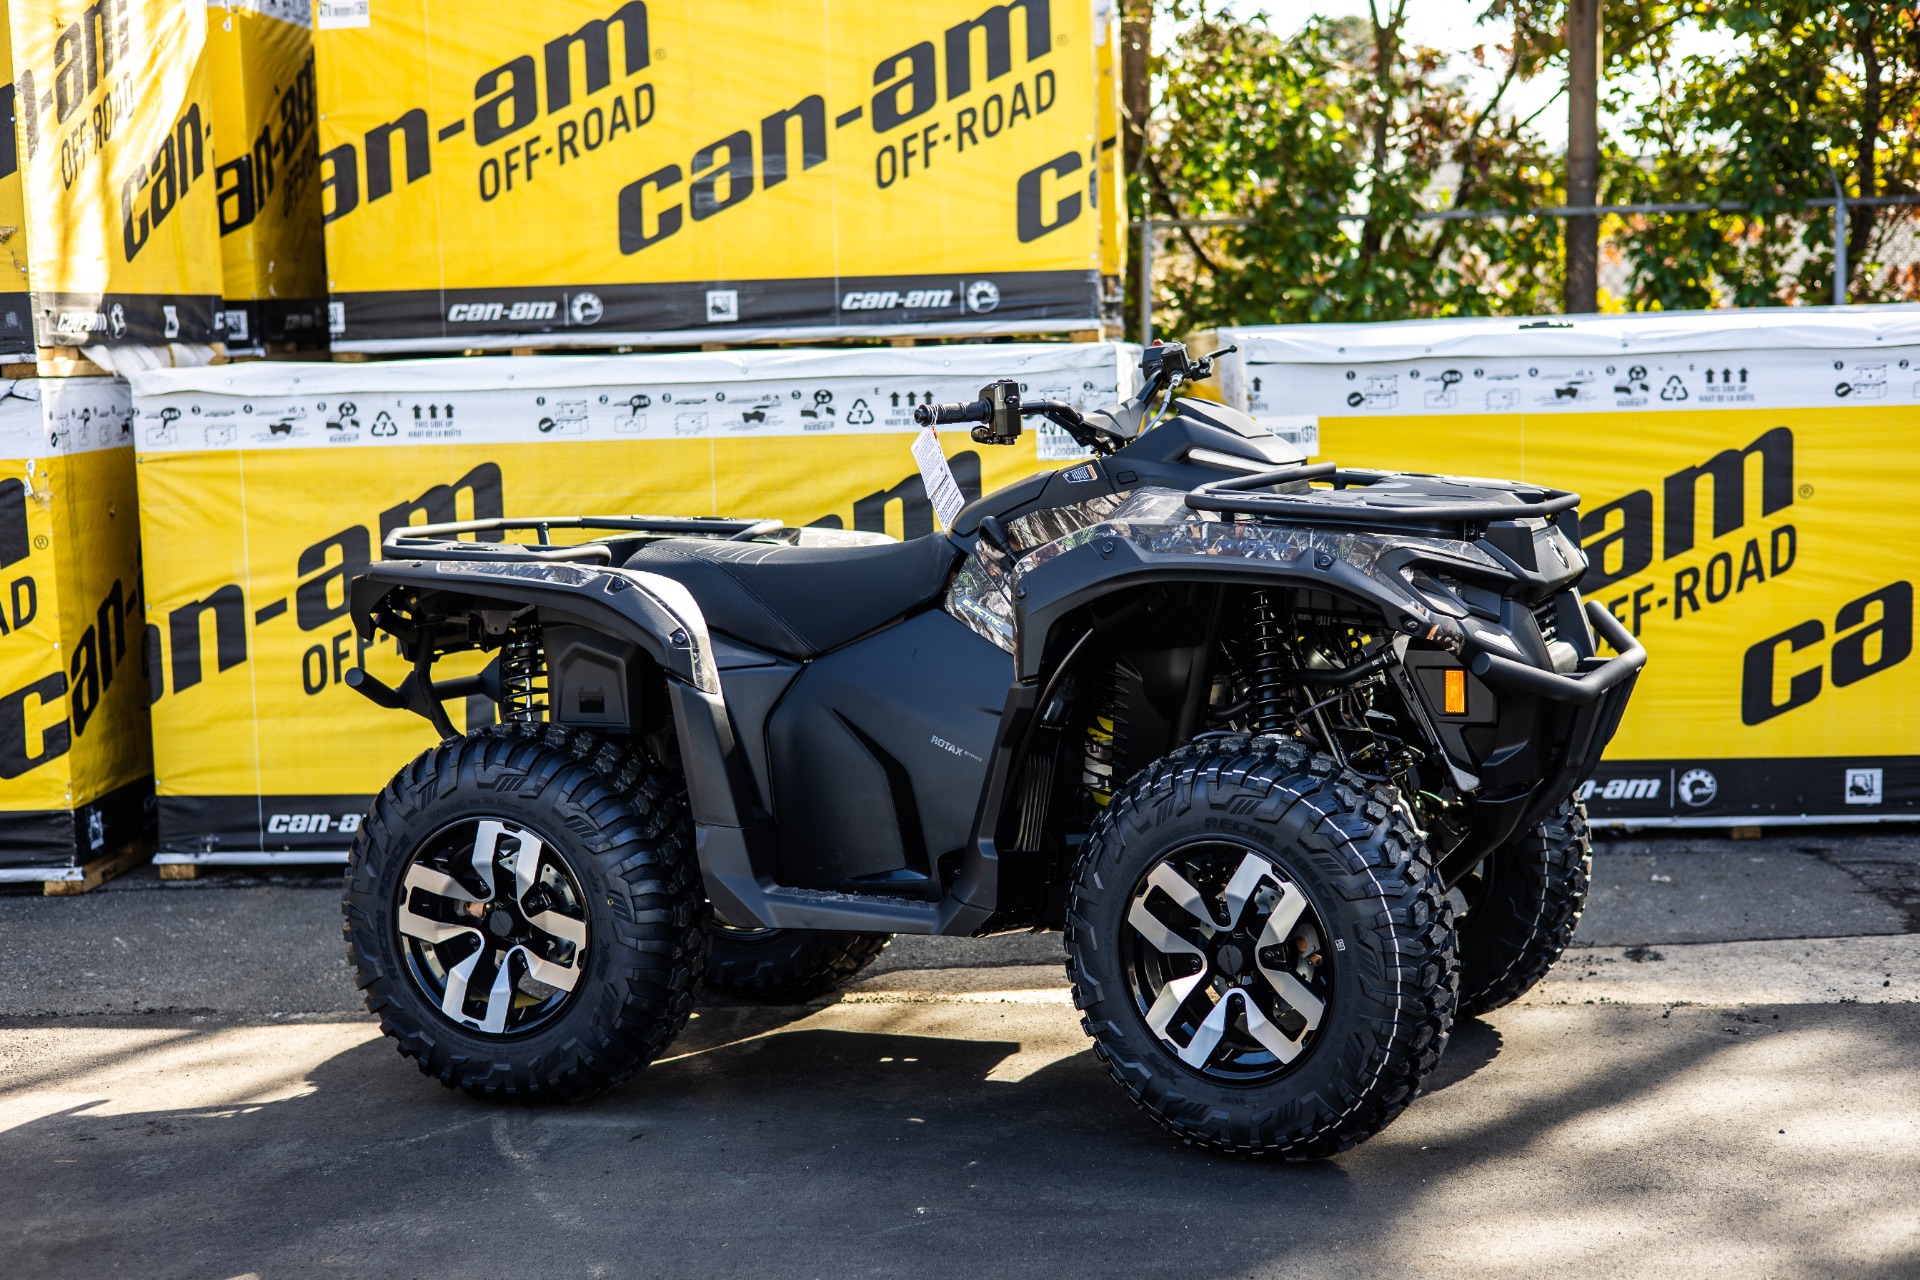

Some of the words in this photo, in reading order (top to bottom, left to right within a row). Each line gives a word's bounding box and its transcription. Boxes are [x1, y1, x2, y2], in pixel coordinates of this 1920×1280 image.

[479, 83, 655, 202] OFF-ROAD
[618, 0, 1051, 256] can-am
[876, 69, 1056, 189] OFF-ROAD
[447, 301, 557, 322] can-am
[841, 289, 954, 310] can-am
[1154, 533, 1292, 553] OUTLANDER
[1593, 524, 1797, 652] FF-ROAD
[962, 598, 1003, 627] ELECTRIC
[303, 629, 403, 695] OFF-
[1741, 580, 1914, 726] ca
[931, 735, 963, 756] ROTAX
[268, 814, 366, 833] can-a
[1205, 818, 1276, 845] RECON
